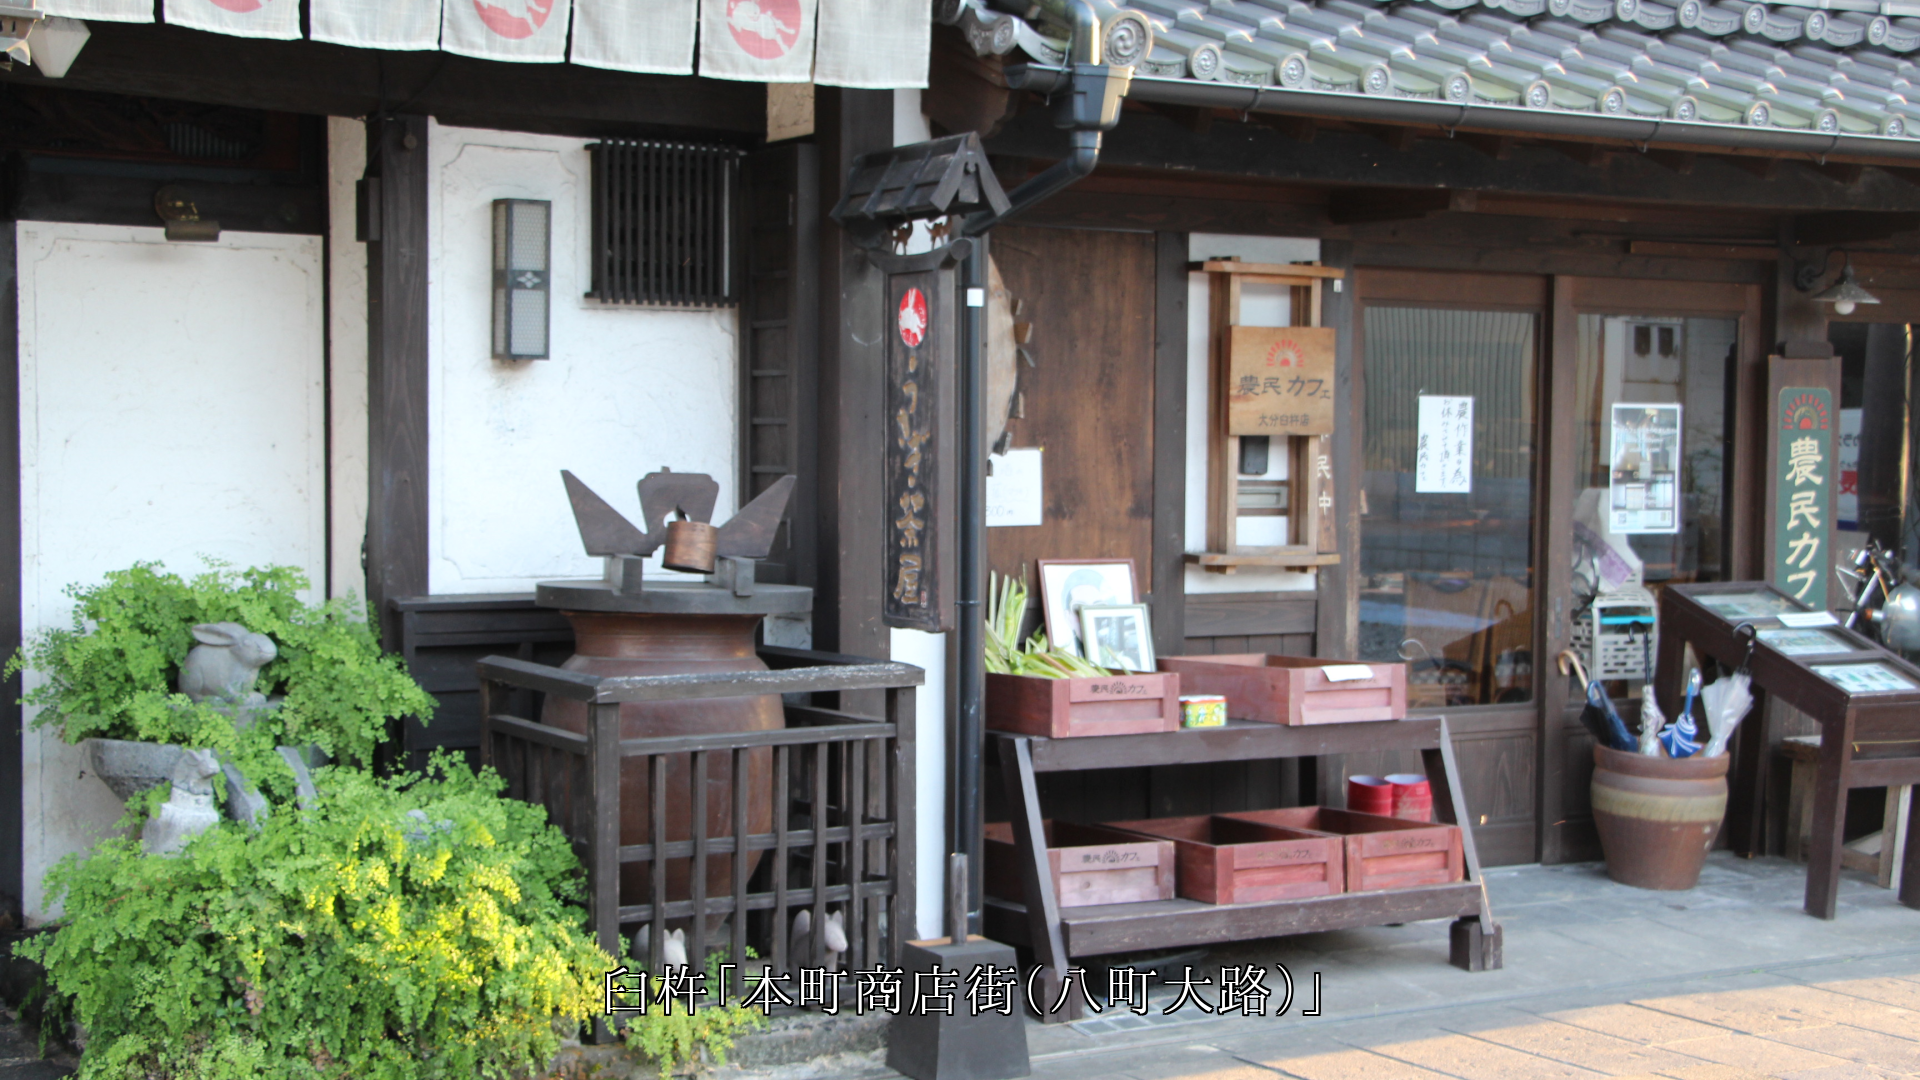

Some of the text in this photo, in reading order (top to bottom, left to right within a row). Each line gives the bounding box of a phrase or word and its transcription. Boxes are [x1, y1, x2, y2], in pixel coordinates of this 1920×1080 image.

[1237, 374, 1331, 399] 農民カフェ
[1258, 413, 1310, 427] 大分臼杵店
[1317, 434, 1331, 515] 民中
[1785, 436, 1824, 608] 農民カフ
